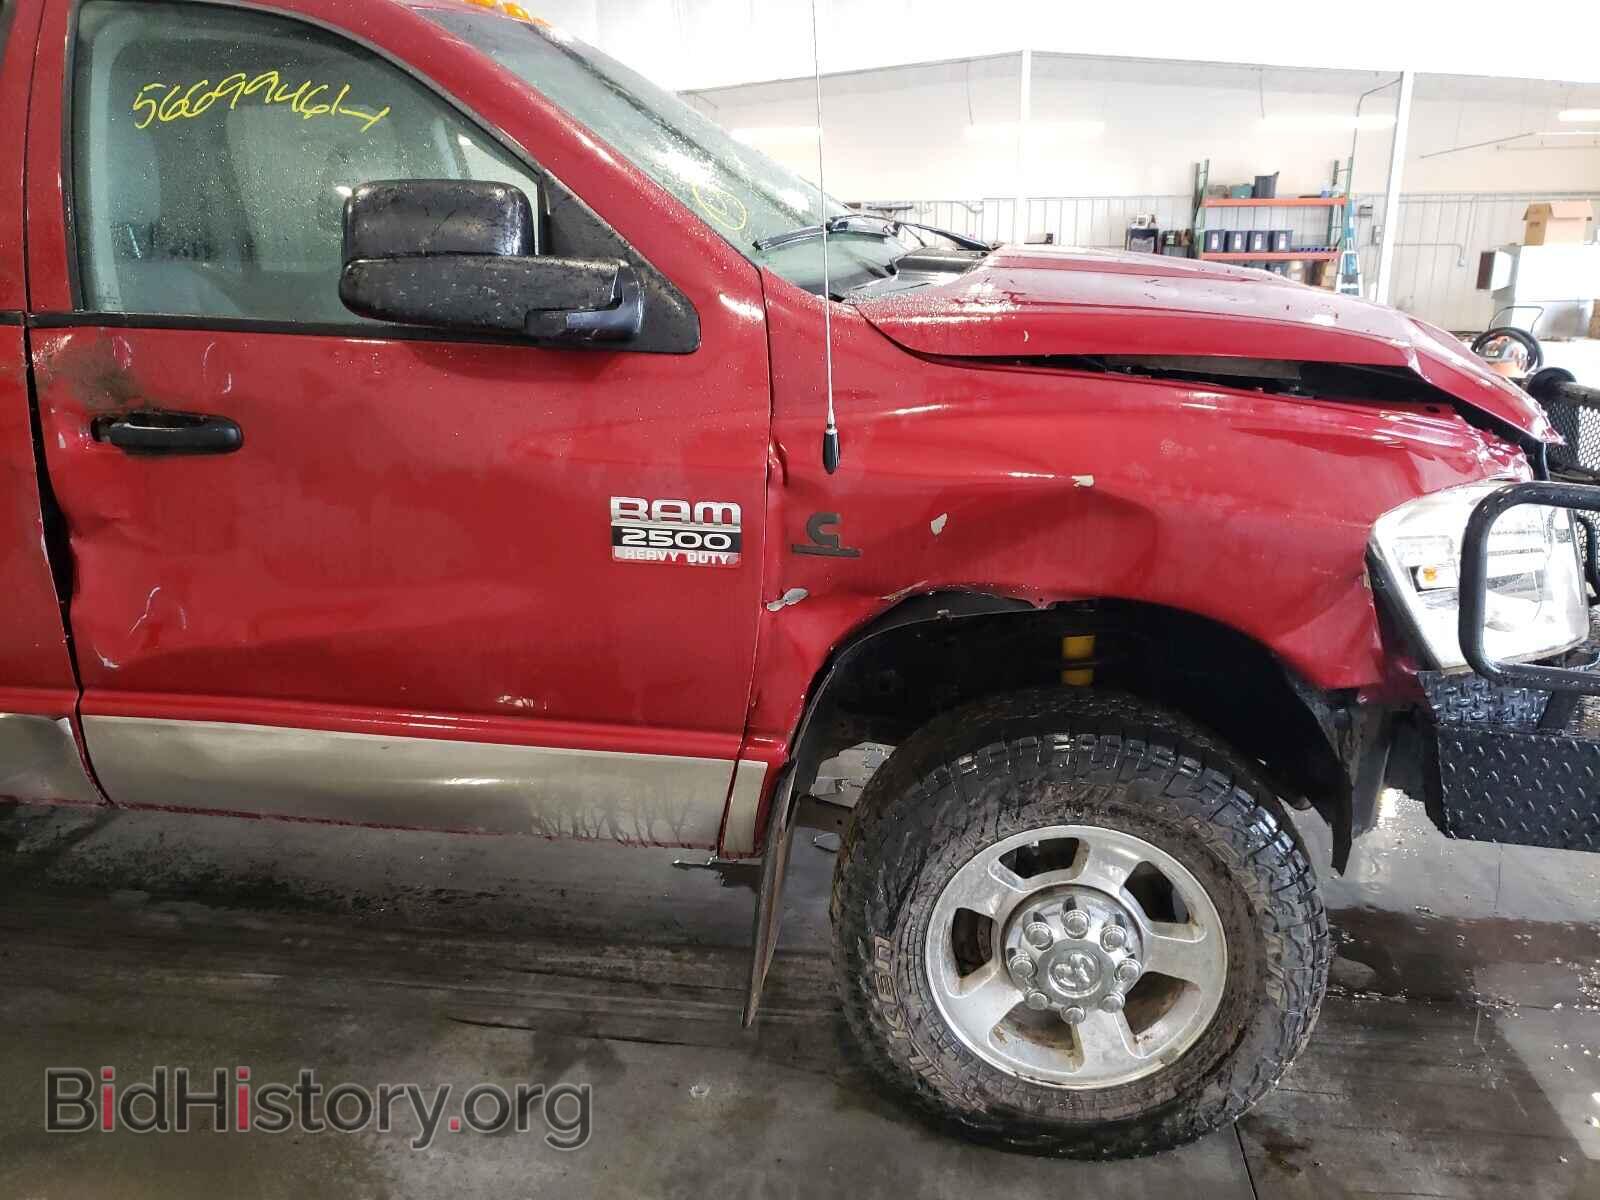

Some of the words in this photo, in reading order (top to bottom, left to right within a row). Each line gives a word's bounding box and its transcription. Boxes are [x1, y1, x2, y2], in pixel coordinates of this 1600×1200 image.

[610, 496, 742, 525] RAM
[621, 528, 732, 550] 2500
[623, 549, 679, 563] HEAVY
[687, 552, 730, 565] DUTY
